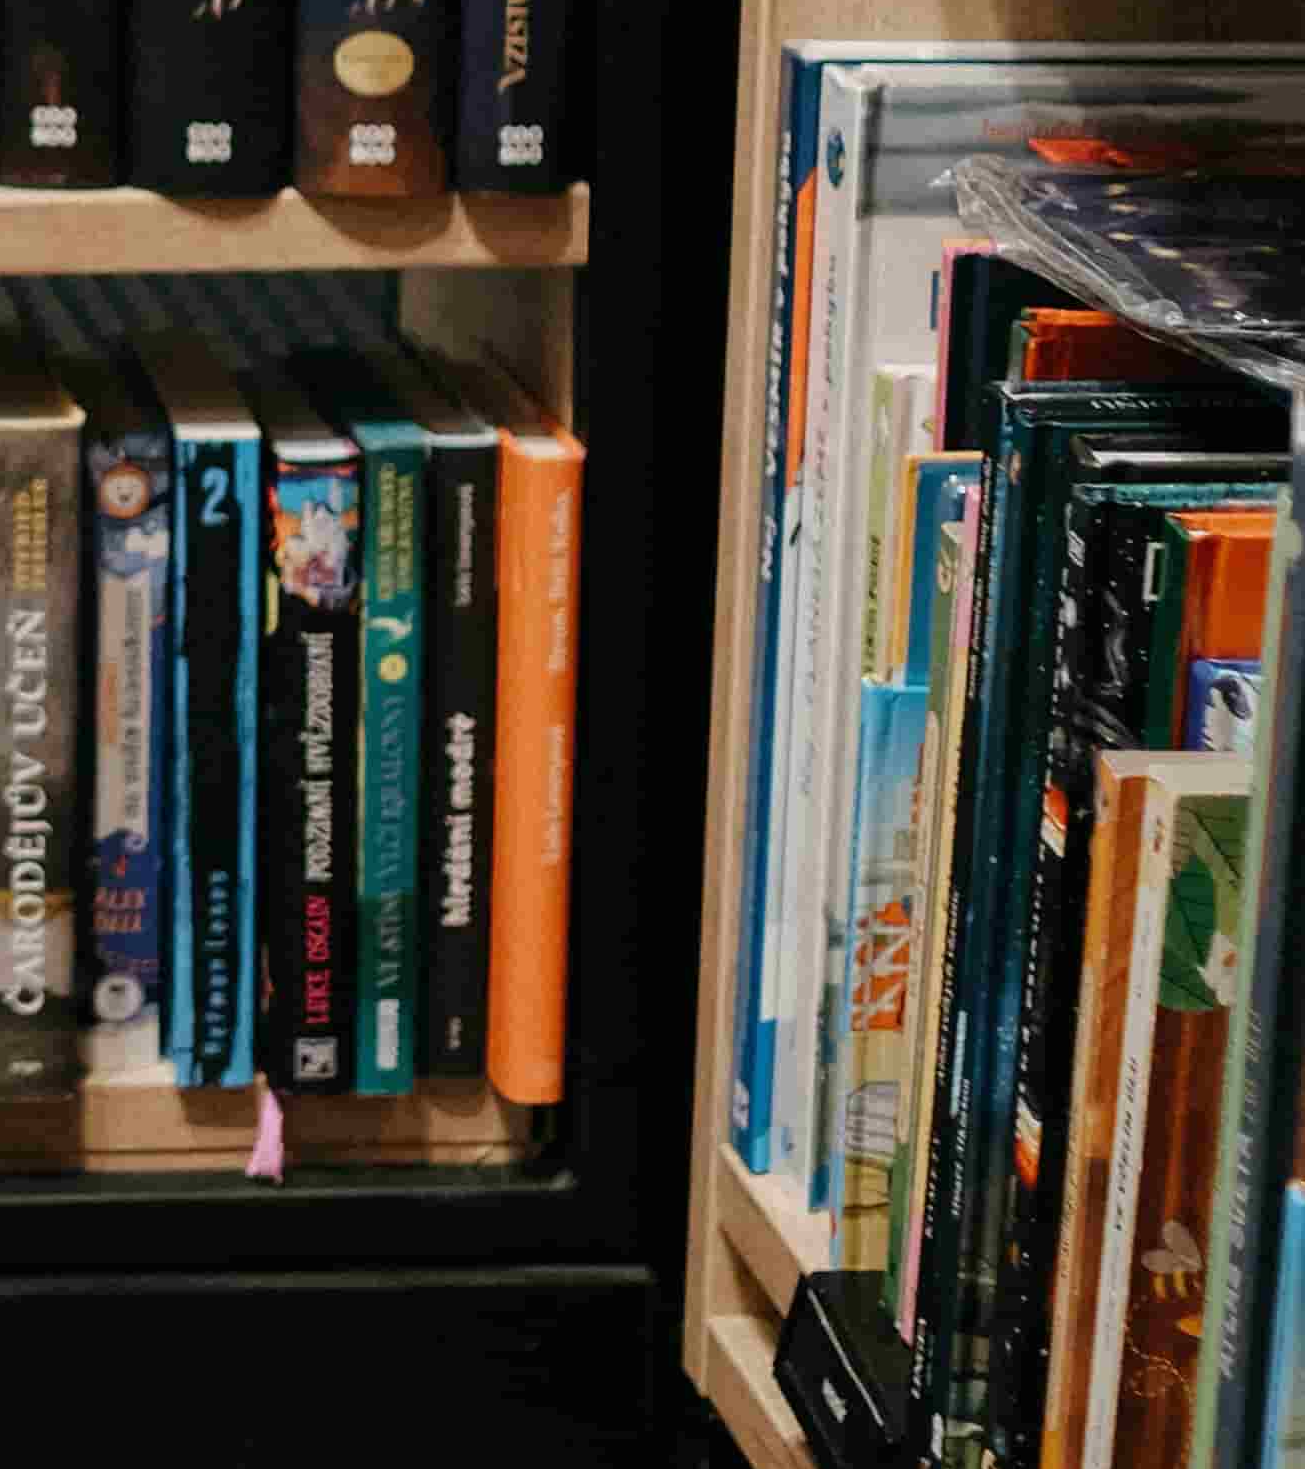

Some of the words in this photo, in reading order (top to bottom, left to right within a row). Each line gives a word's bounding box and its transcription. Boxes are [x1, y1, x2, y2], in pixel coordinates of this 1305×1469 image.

[199, 466, 230, 527] 2
[3, 611, 50, 742] UČEŇ
[3, 753, 54, 1016] ČARODĚJŮV
